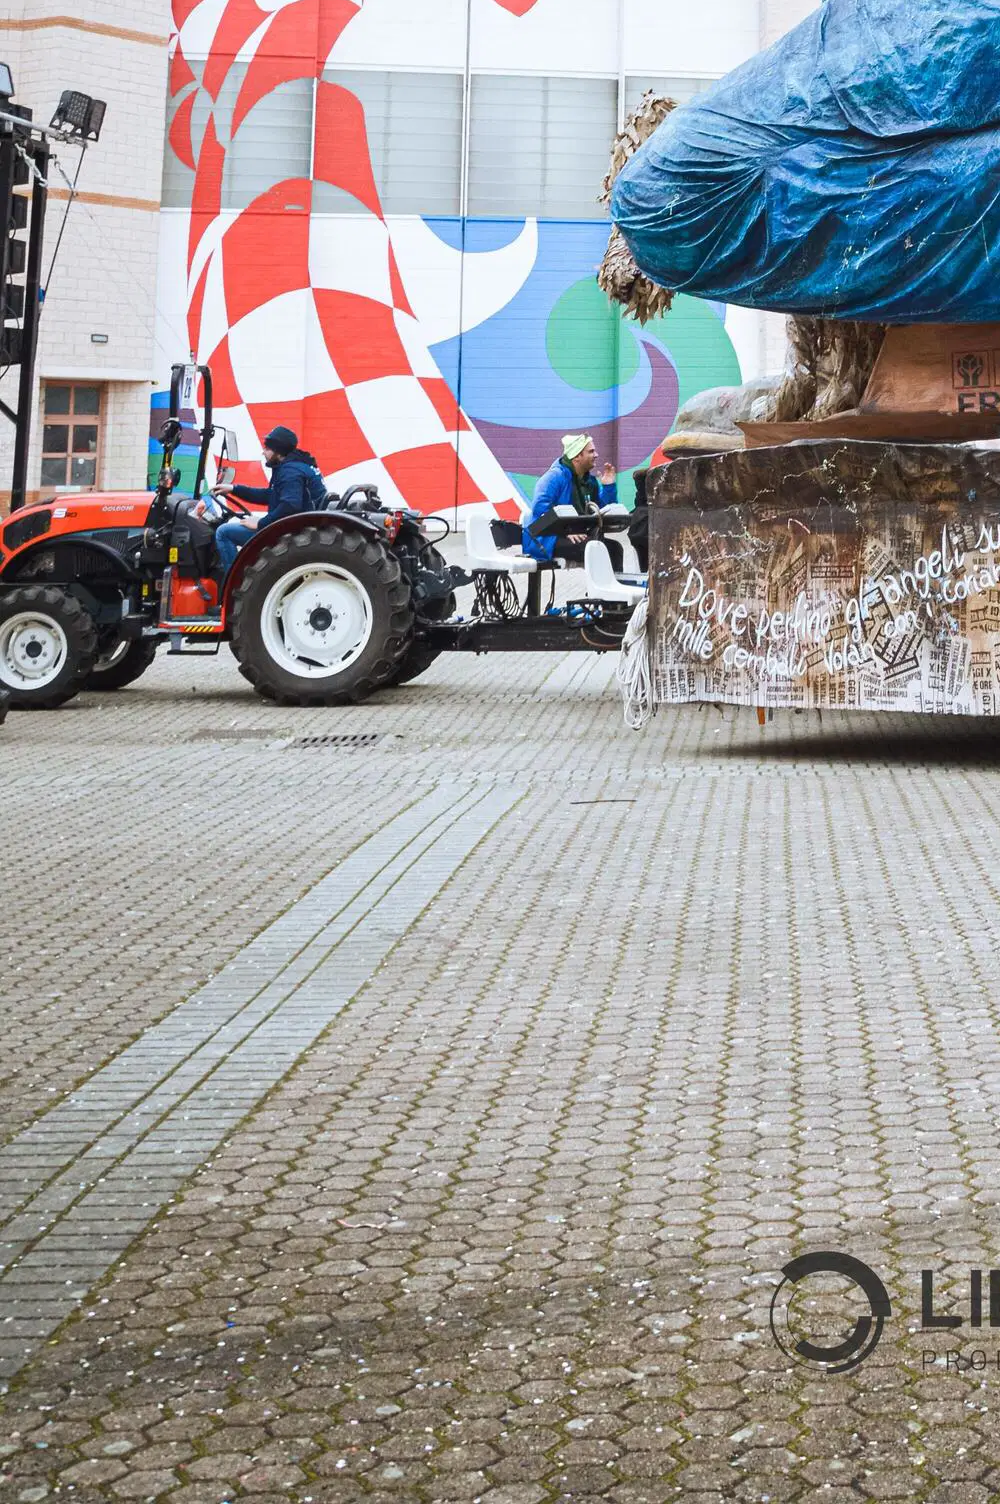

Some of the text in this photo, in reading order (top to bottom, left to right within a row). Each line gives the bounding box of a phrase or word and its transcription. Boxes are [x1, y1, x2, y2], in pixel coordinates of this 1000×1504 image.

[755, 590, 832, 648] perfino
[884, 523, 966, 605] angeli
[672, 614, 714, 660] mille
[722, 641, 809, 679] cembali
